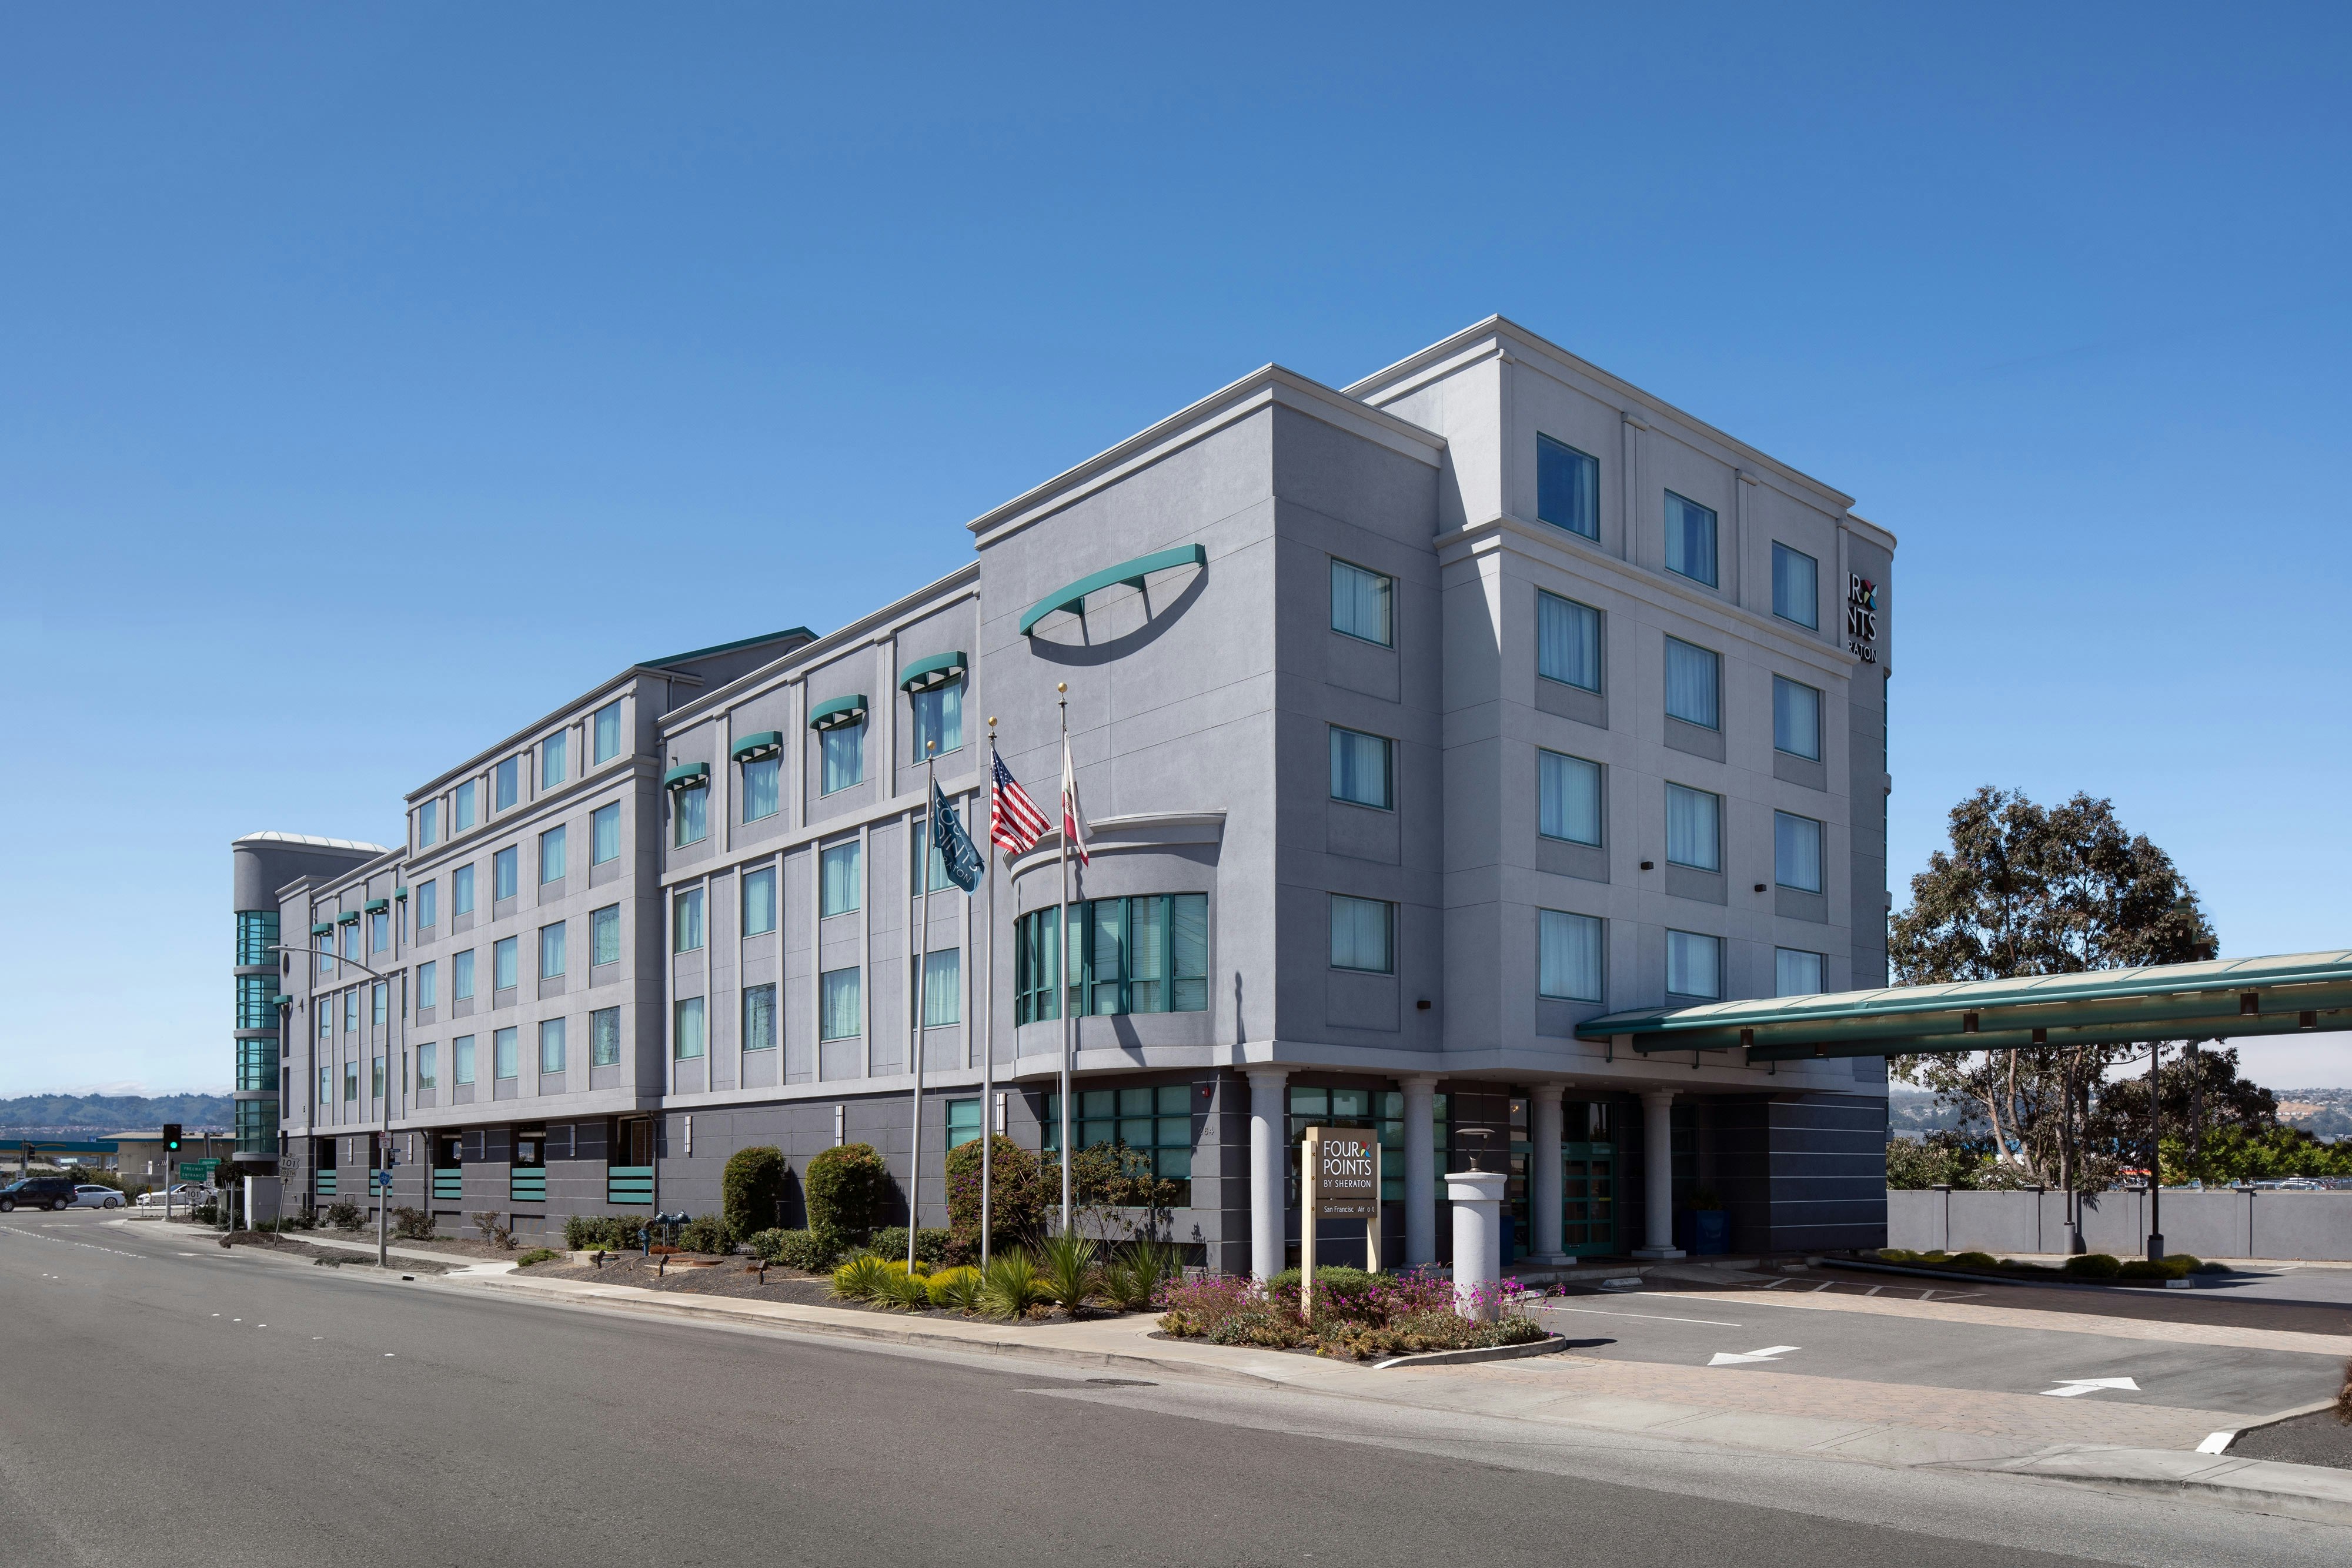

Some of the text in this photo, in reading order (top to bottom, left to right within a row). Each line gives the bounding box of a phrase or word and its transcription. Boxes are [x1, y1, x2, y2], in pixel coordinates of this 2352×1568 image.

[1848, 640, 1877, 663] RATON
[1198, 1126, 1214, 1136] 264
[1324, 1141, 1360, 1158] FOUR
[282, 1159, 296, 1168] 101
[1324, 1158, 1371, 1176] POINTS
[1324, 1179, 1371, 1188] BY SHERATON
